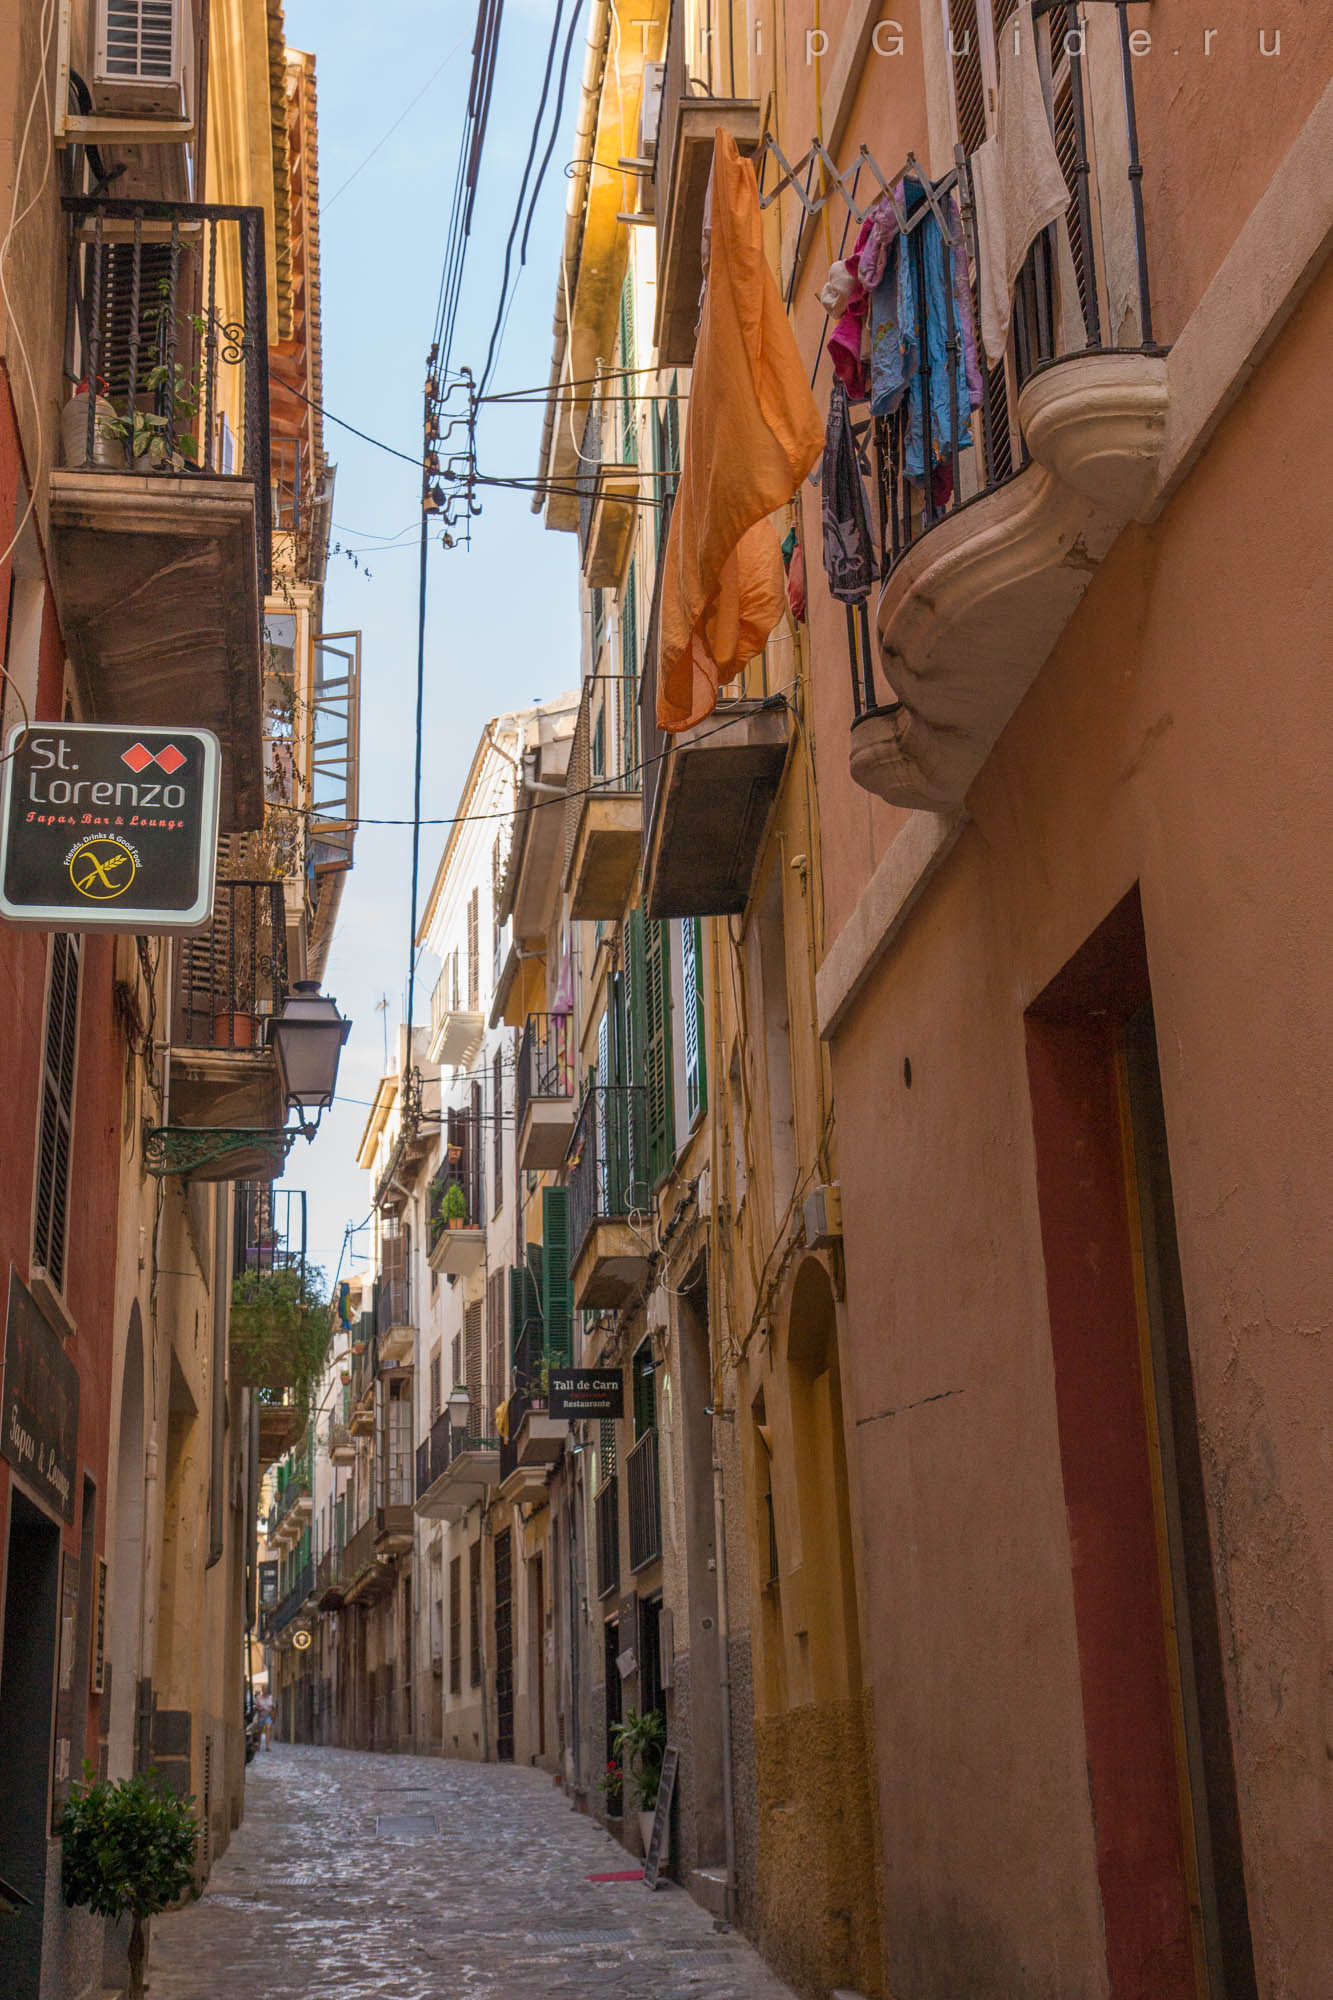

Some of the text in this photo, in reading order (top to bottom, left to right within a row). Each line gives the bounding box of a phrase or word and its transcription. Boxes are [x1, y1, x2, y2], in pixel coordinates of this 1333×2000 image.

[30, 738, 79, 770] St.
[29, 772, 185, 808] Lorenzo
[25, 811, 184, 830] Tapas, Bar & Lounge
[63, 841, 84, 866] Friends,
[83, 832, 107, 843] Drinks
[116, 835, 135, 851] Good
[131, 848, 143, 868] Food
[553, 1380, 619, 1390] Tall de Carn
[563, 1400, 611, 1408] Restaurante
